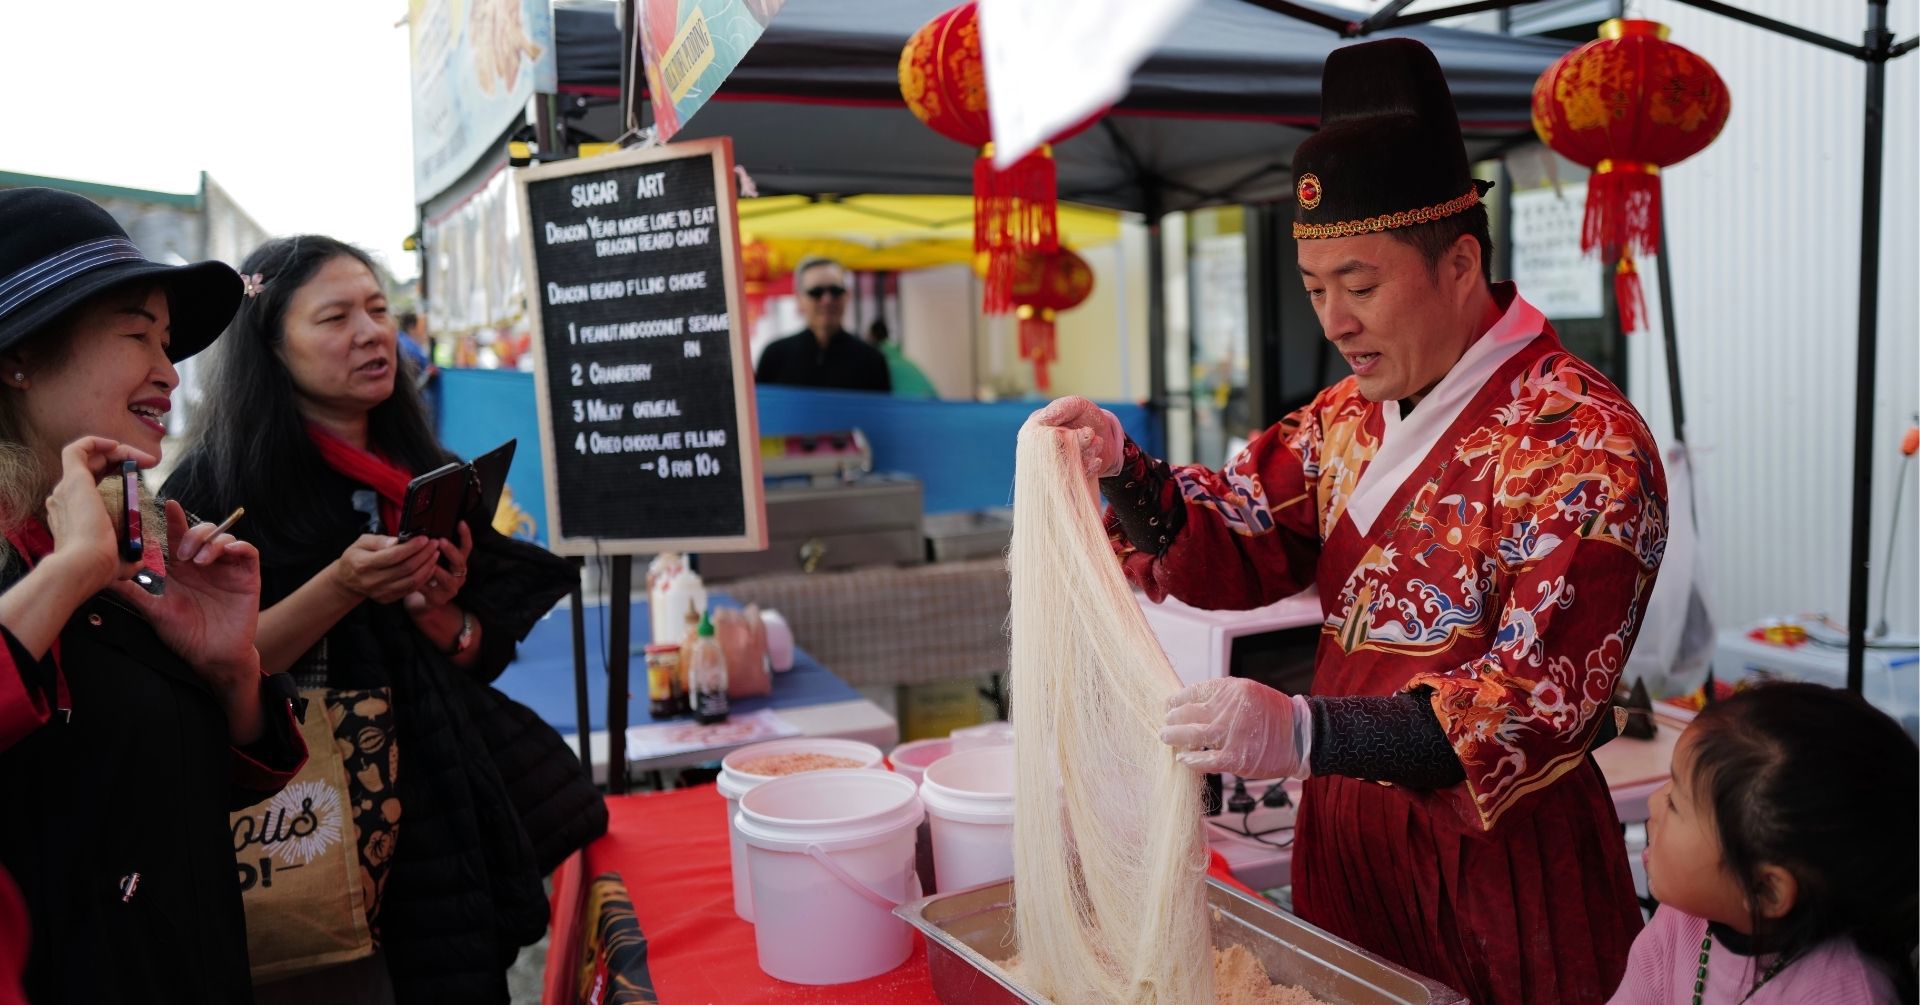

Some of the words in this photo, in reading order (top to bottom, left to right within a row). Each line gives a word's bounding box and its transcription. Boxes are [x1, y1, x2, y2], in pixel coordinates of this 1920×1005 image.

[571, 180, 619, 207] SUGAR
[637, 172, 665, 199] ART
[545, 222, 588, 244] DRAGON
[586, 216, 617, 239] YEAR
[618, 215, 650, 236] MORE
[650, 212, 678, 230] LOVE
[677, 210, 691, 227] TO
[693, 206, 715, 225] EAT
[596, 236, 637, 257] DRAGON
[638, 232, 674, 251] BEARD
[676, 228, 709, 247] CANDY
[548, 282, 589, 305] DRAGON
[590, 281, 625, 300] BEARD
[669, 271, 706, 291] CHOICE
[568, 323, 576, 344] 1
[688, 312, 729, 332] SESAME
[571, 364, 583, 386] 2
[589, 362, 651, 384] CRANBERRY
[573, 400, 584, 422] 3
[587, 399, 623, 421] MILKY
[633, 400, 680, 418] OATMEAL
[575, 433, 586, 454] 4
[590, 432, 622, 453] OREO
[623, 433, 681, 451] CHOCOLATE
[685, 430, 725, 447] FILLING
[658, 456, 669, 478] 8
[672, 461, 692, 477] FOR
